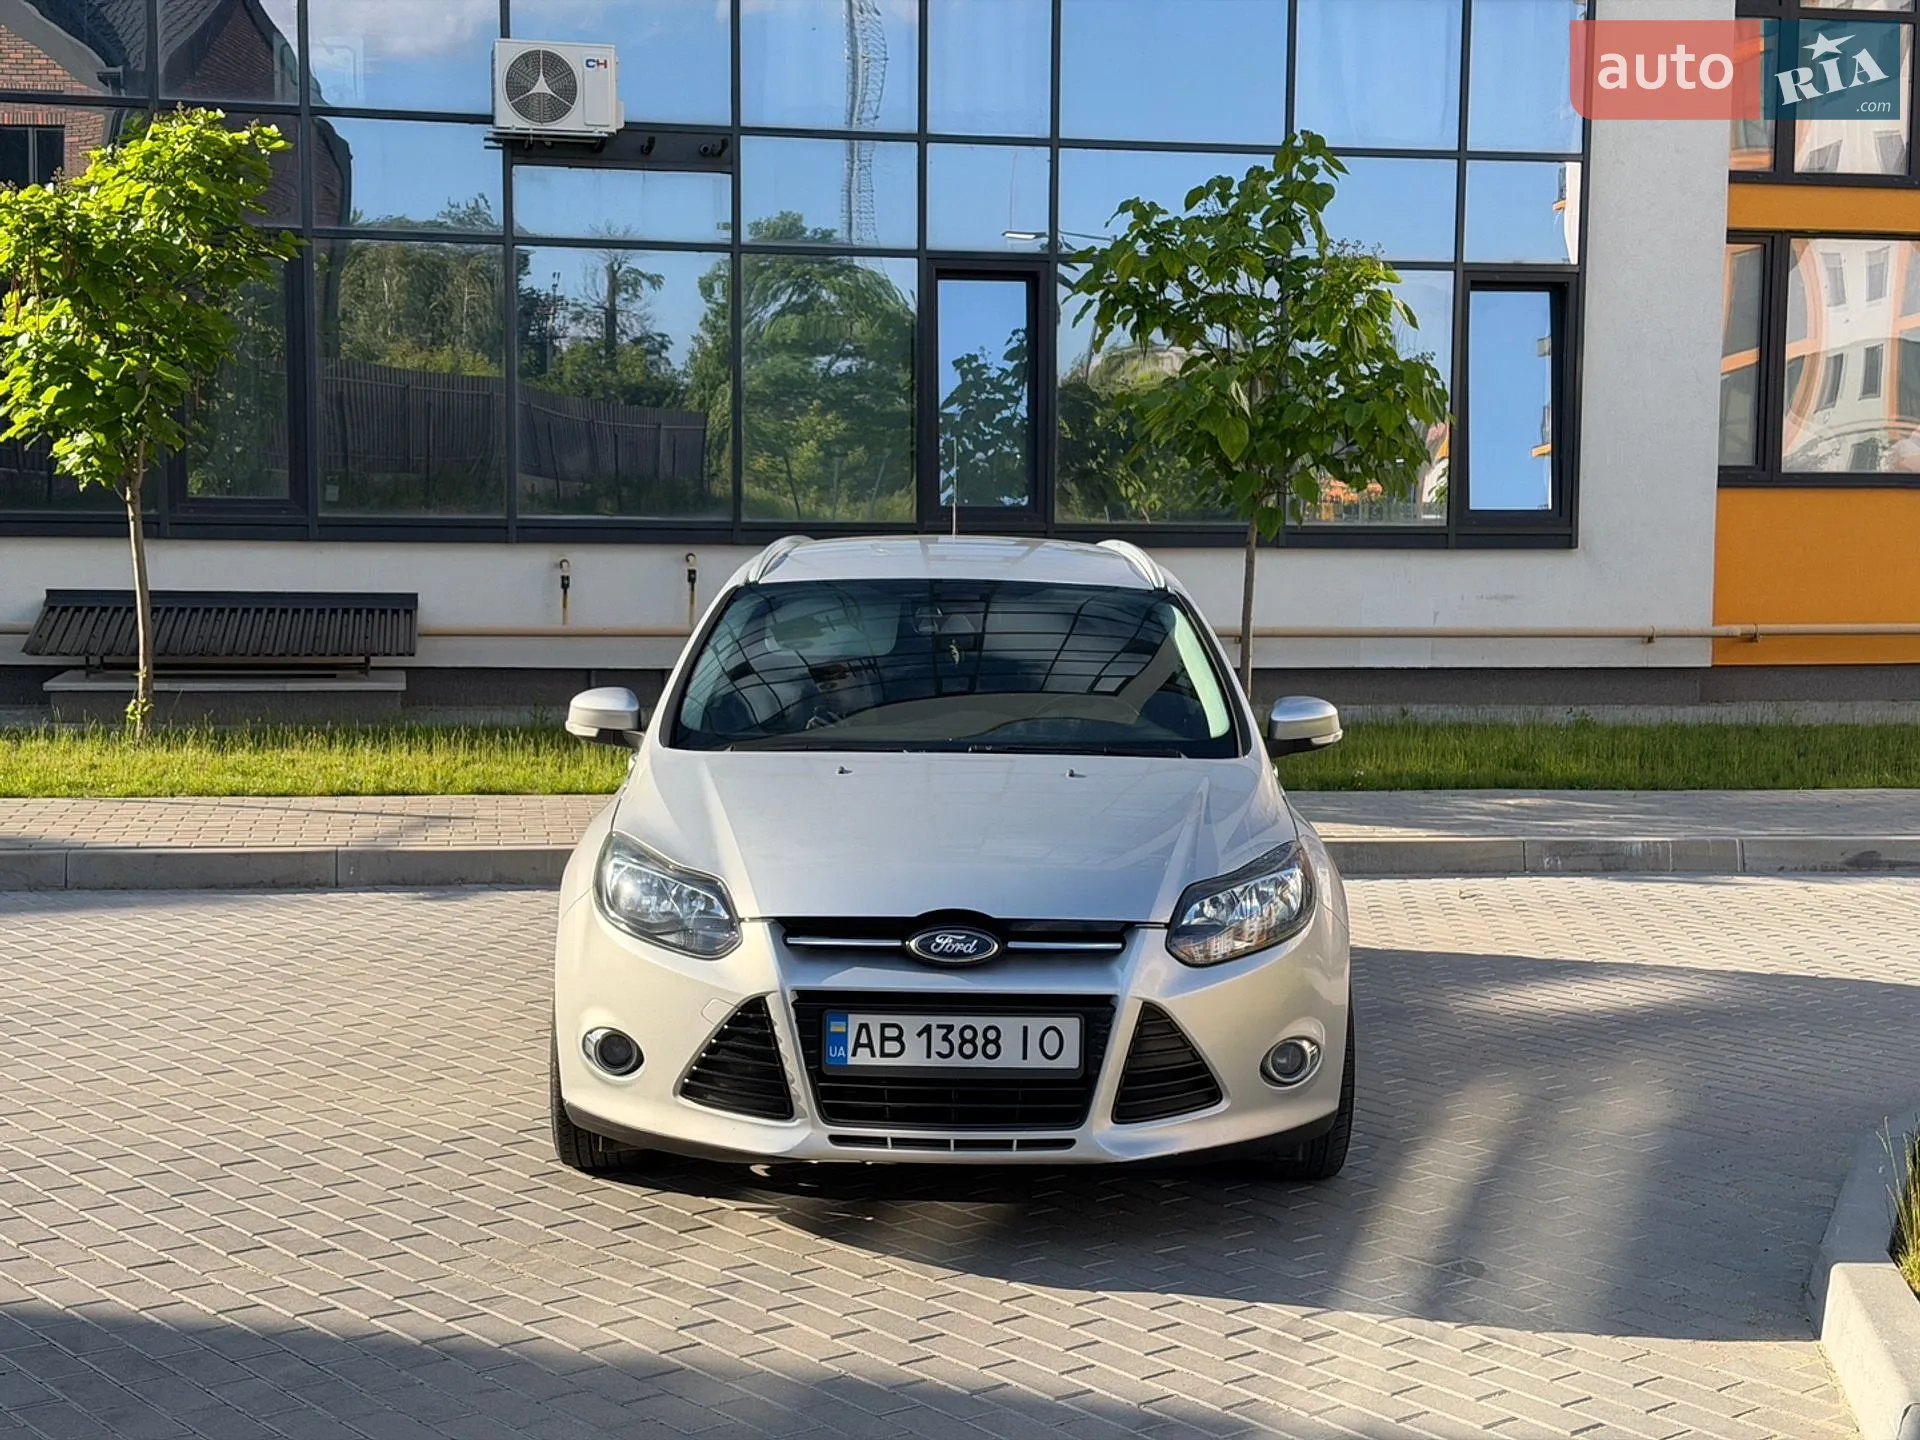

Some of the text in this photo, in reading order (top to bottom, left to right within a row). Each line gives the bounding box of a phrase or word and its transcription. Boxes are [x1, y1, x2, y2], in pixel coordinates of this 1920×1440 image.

[930, 933, 978, 954] Ford
[829, 1045, 846, 1058] UA
[851, 1022, 906, 1059] AB
[916, 1023, 1002, 1061] 1388
